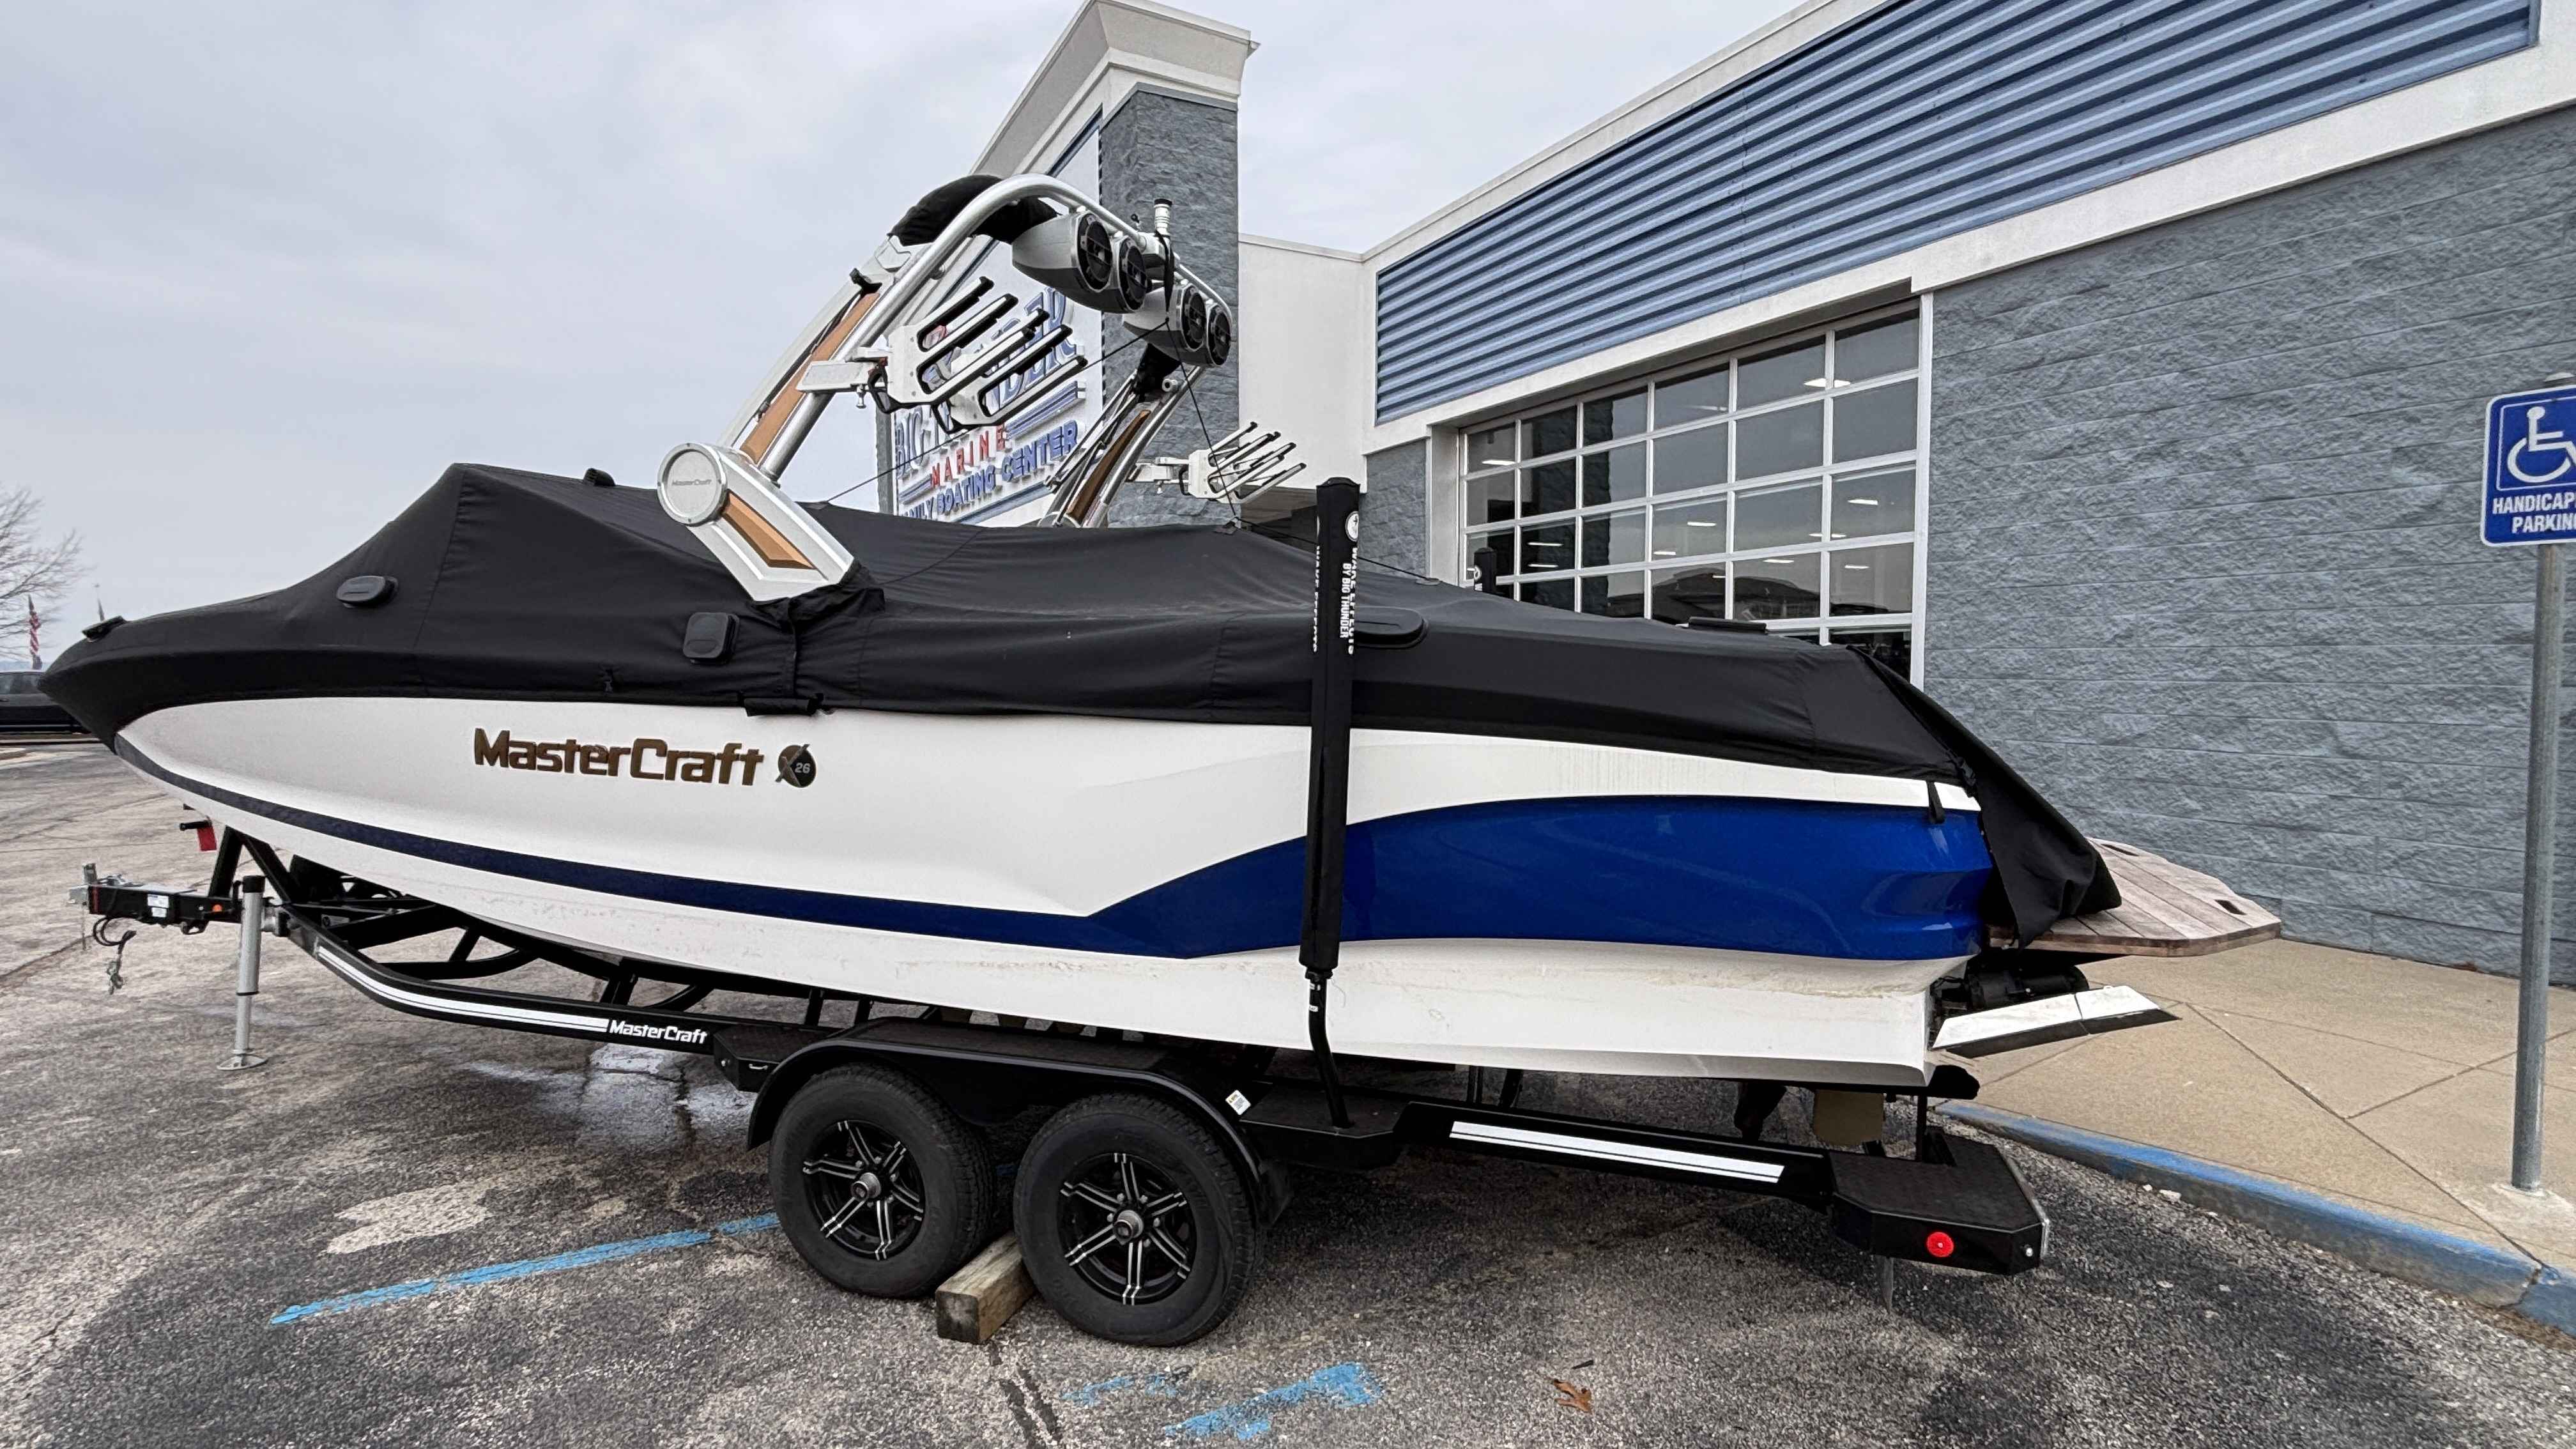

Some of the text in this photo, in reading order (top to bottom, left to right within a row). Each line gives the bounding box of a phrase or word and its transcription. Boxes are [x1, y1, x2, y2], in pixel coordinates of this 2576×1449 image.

[931, 424, 1006, 489] MARINE
[937, 464, 996, 515] BOATING
[1000, 419, 1078, 482] CENTER
[2492, 491, 2576, 514] HANDICAP
[1340, 563, 1352, 638] BY BIG THUNDER
[474, 727, 764, 786] MasterCraft
[609, 1020, 708, 1044] MasterCraft
